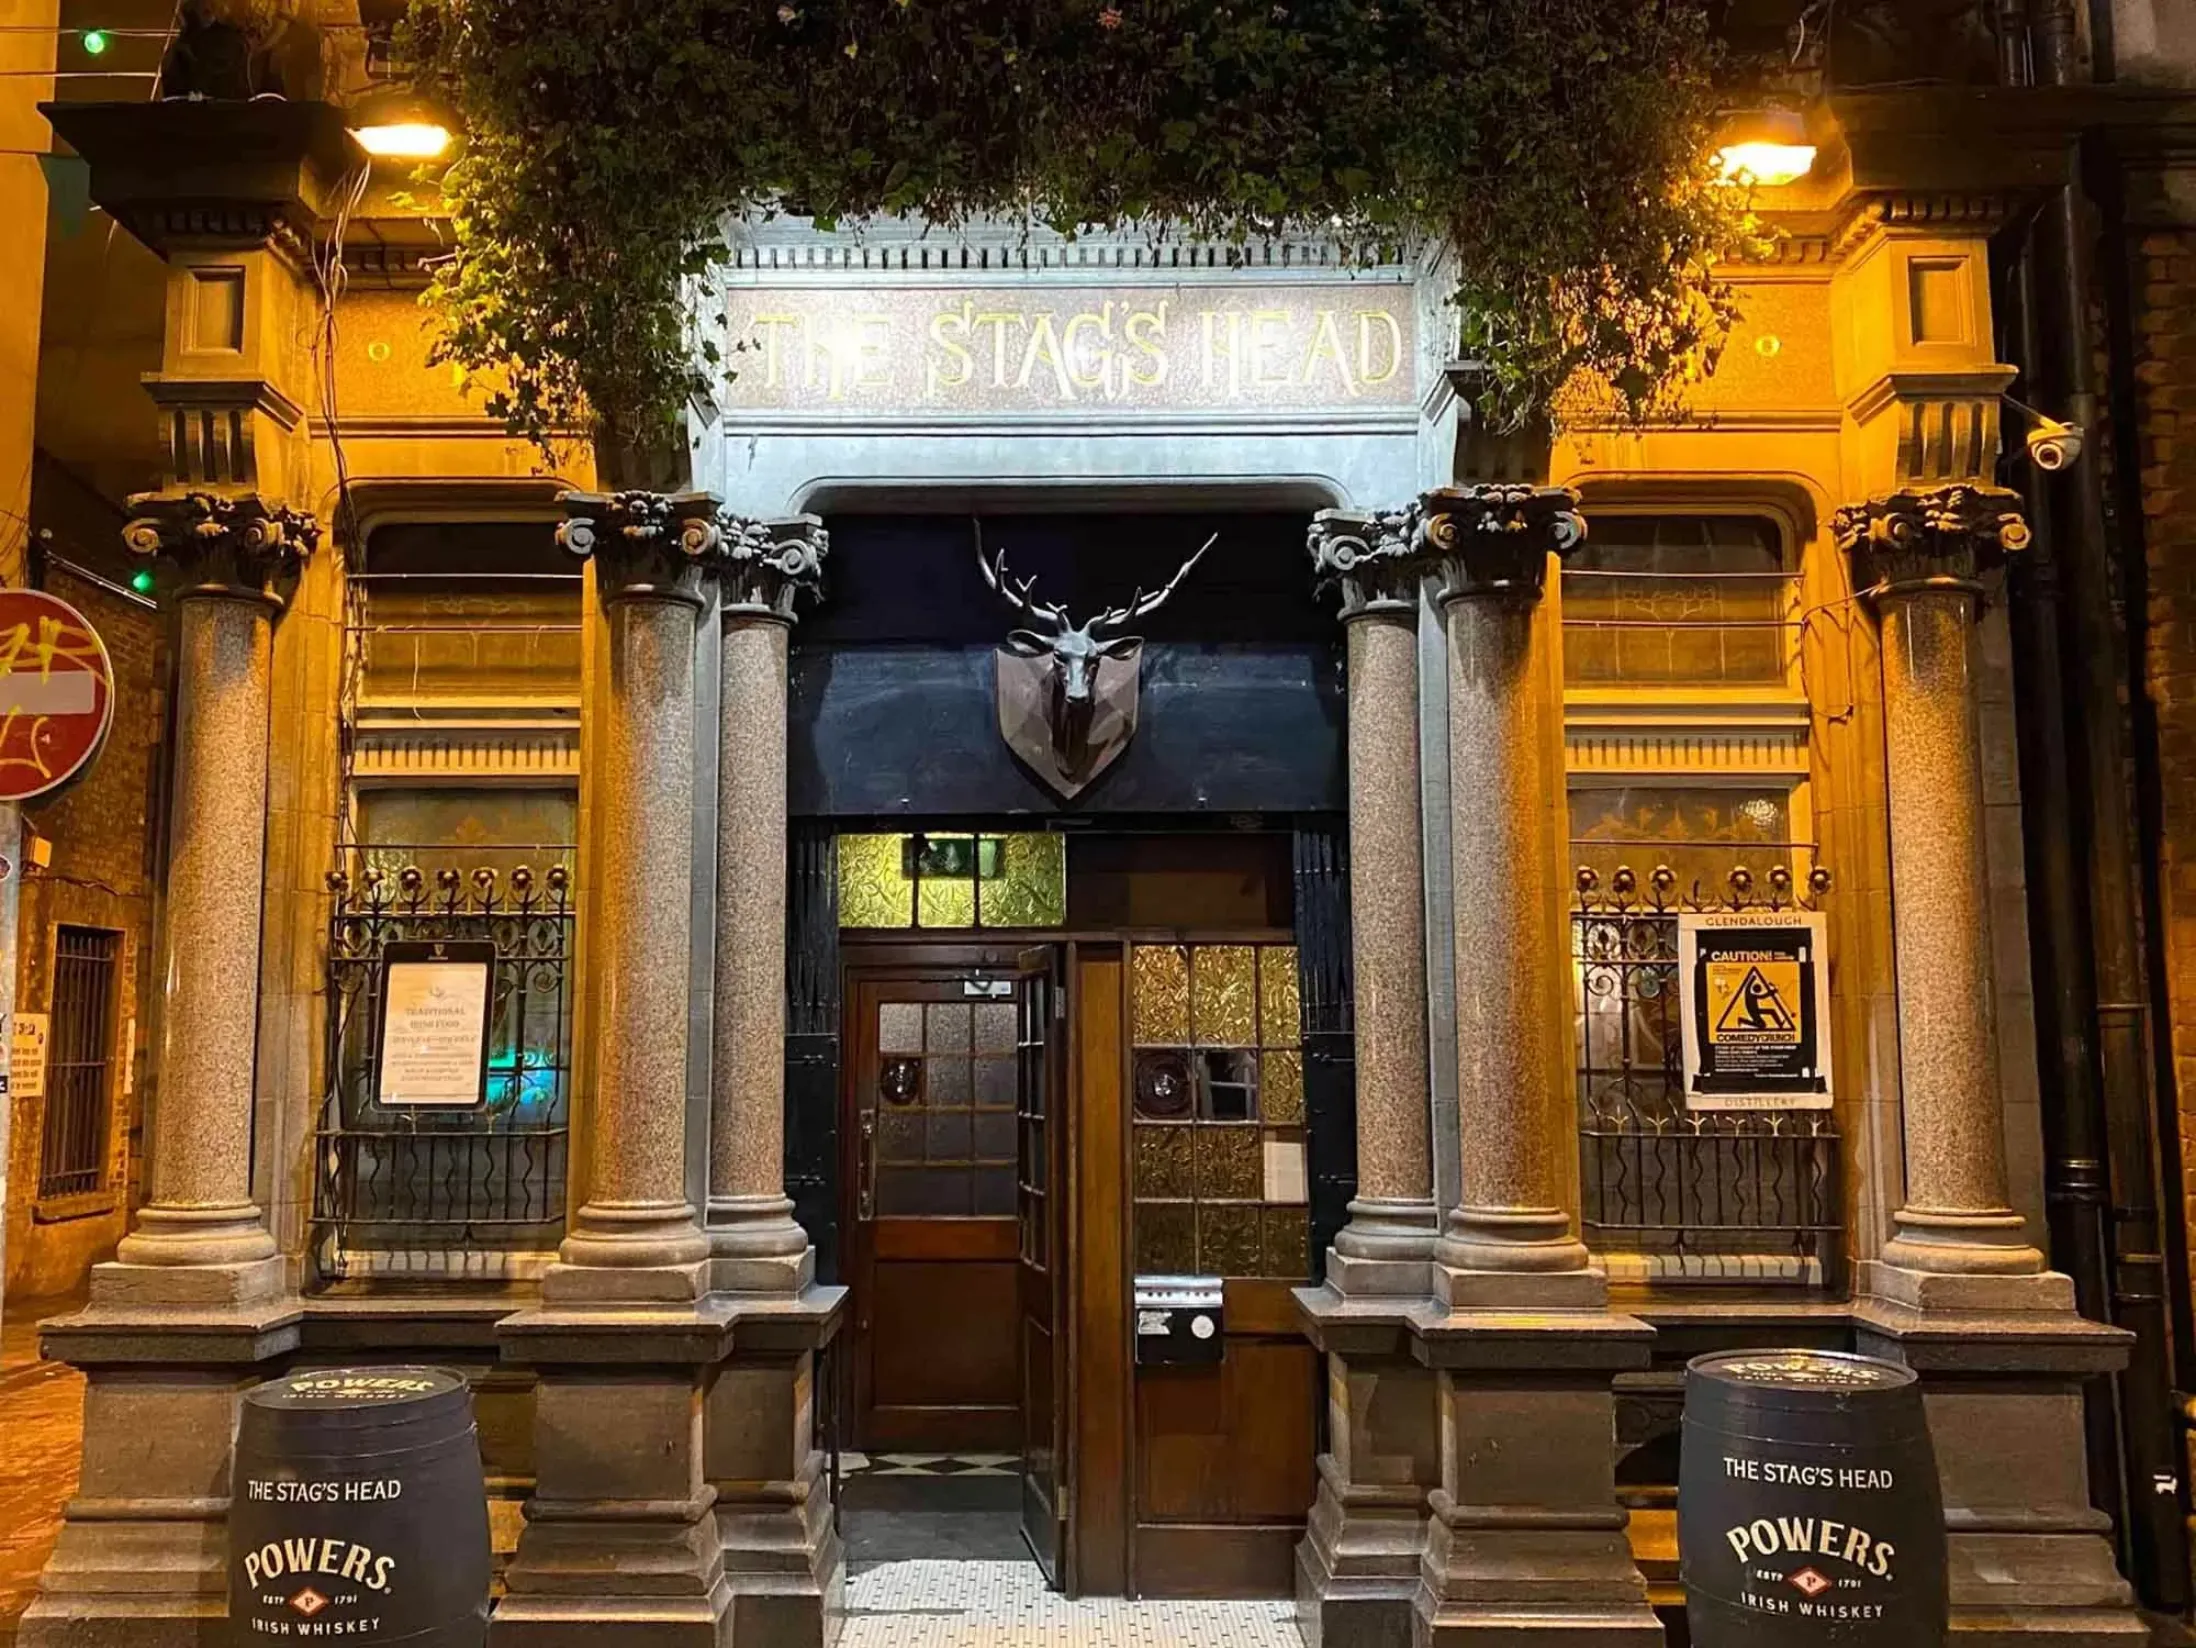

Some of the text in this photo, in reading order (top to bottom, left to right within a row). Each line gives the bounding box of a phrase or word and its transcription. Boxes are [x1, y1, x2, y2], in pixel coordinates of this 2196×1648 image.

[749, 299, 1401, 400] THE STAG'S HEAD
[1705, 916, 1801, 926] GLENDALOUGH
[1711, 951, 1773, 962] CAUTION!
[1724, 1097, 1796, 1108] DISTILLERY
[290, 1378, 435, 1392] POWERS
[1723, 1457, 1893, 1489] THE STAG'S HEAD
[248, 1480, 402, 1502] THE STAG'S HEAD
[1741, 1591, 1883, 1619] IRISH WHISKEY
[251, 1616, 380, 1636] IRISH WHISKEY
